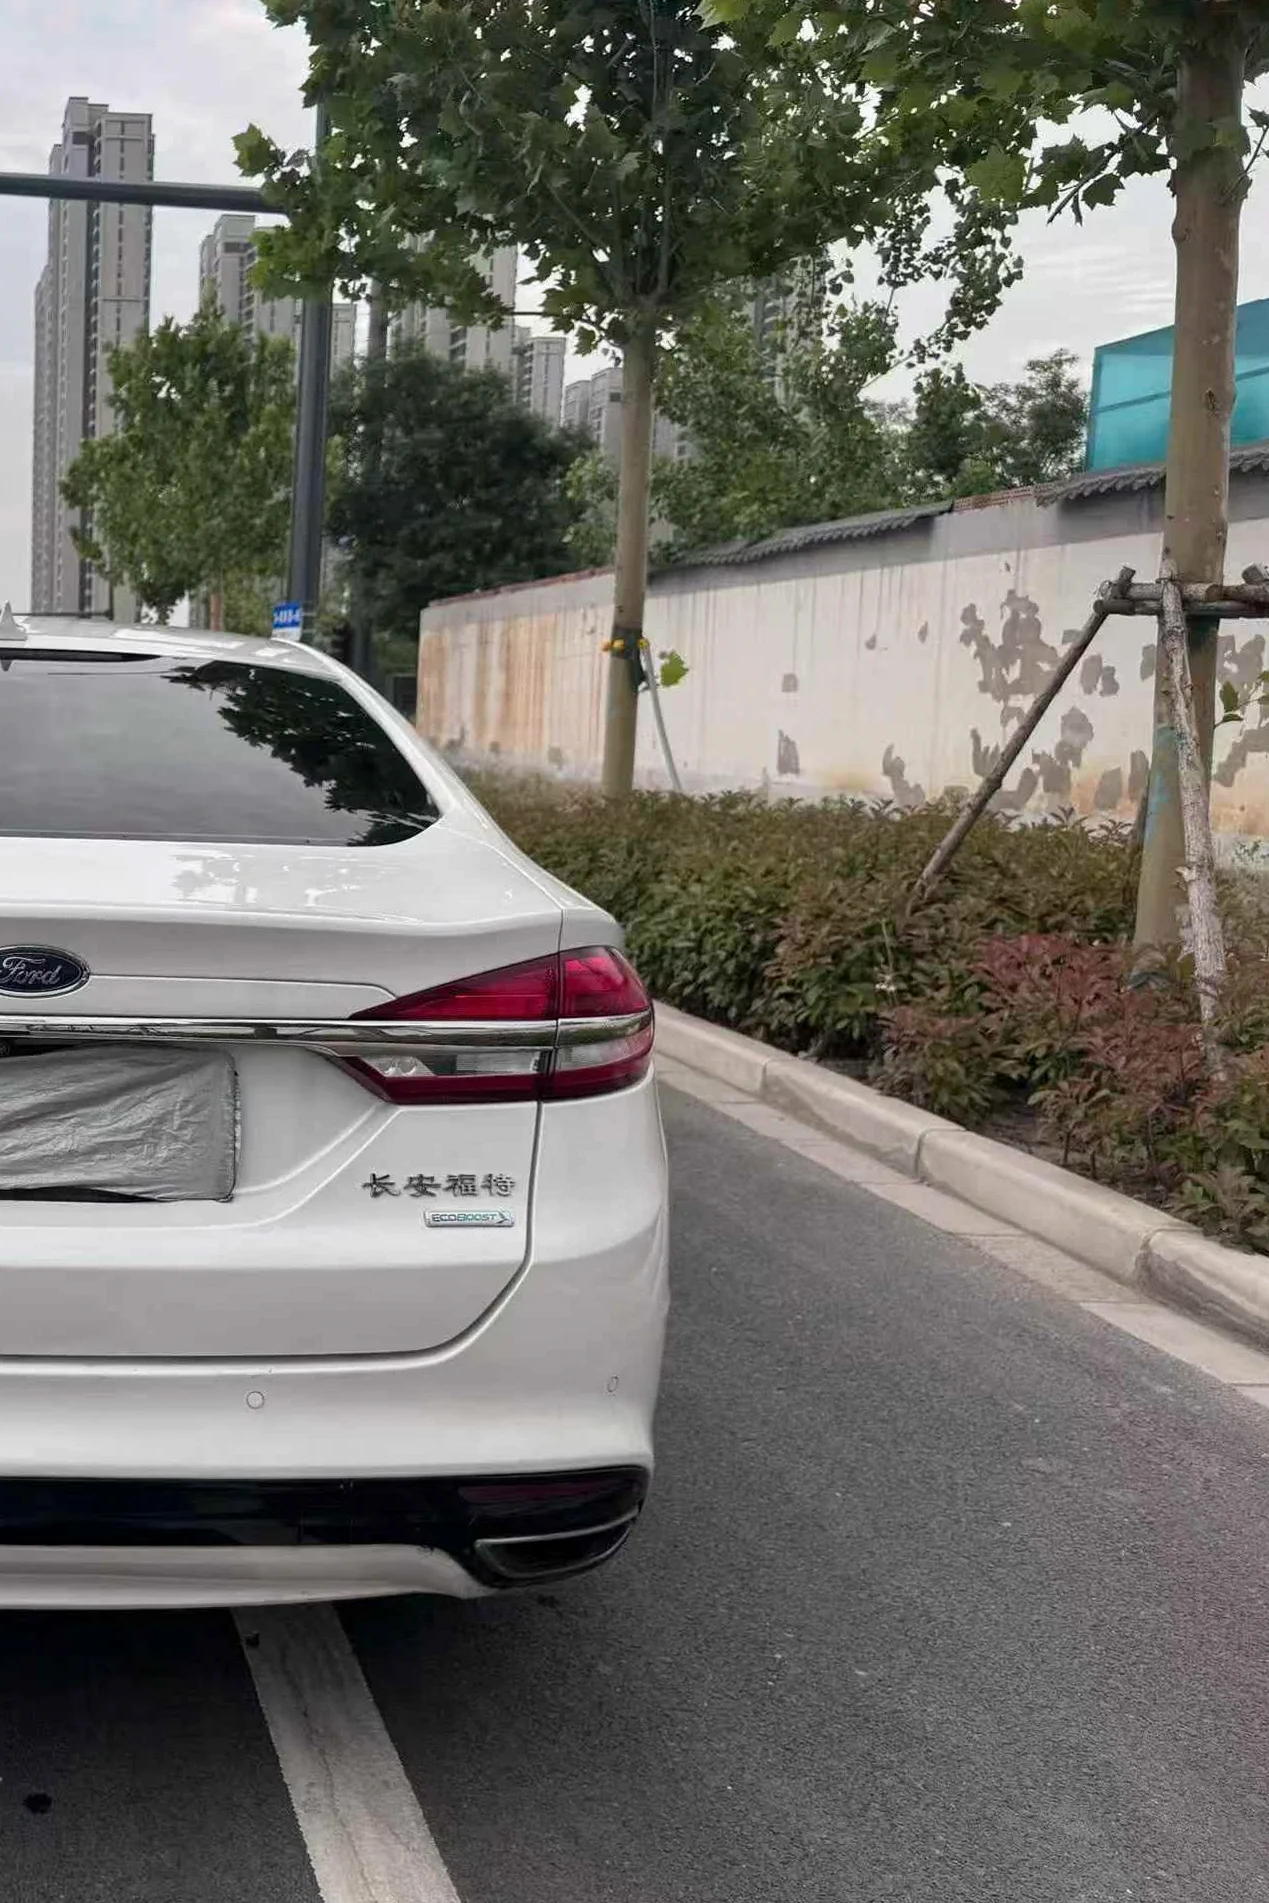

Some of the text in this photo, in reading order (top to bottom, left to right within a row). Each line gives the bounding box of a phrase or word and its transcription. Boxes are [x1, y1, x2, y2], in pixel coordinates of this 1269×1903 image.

[362, 1172, 516, 1199] 长安福特
[431, 1212, 498, 1223] ECOBOOST
